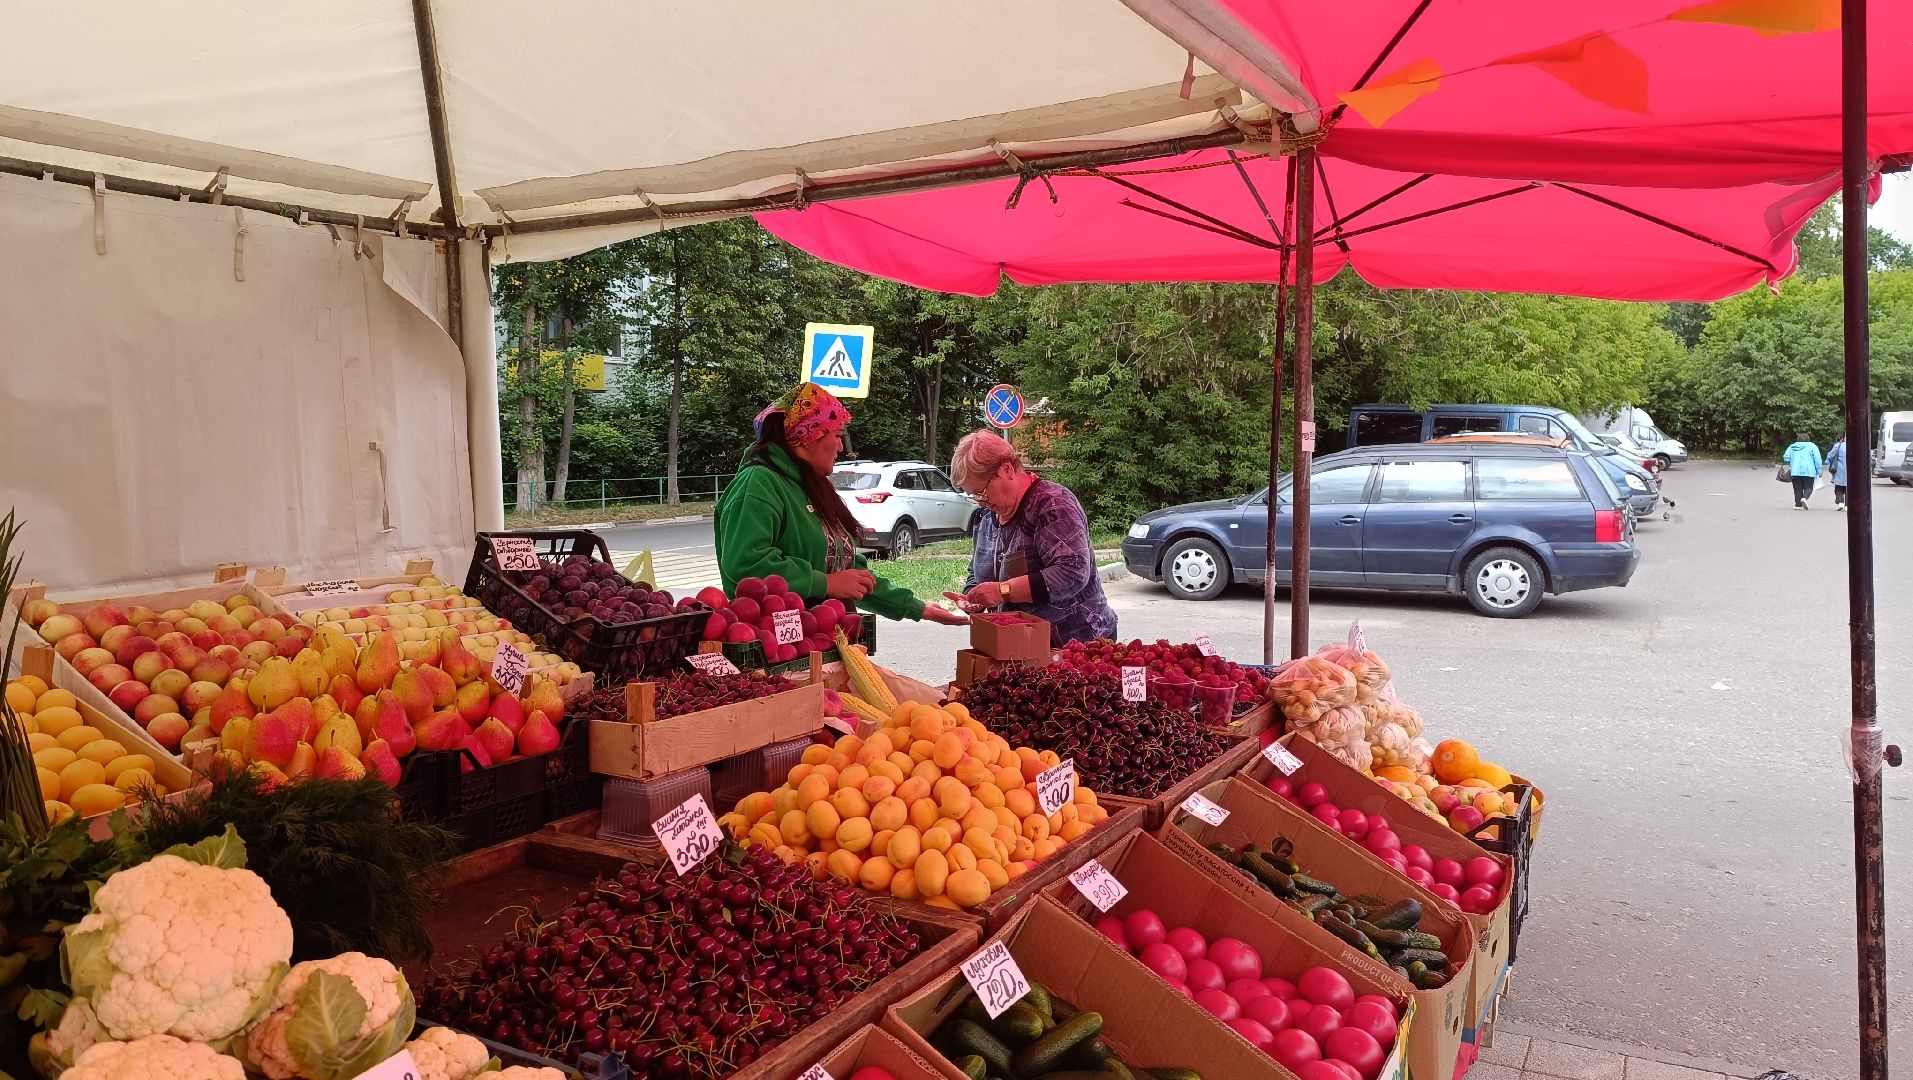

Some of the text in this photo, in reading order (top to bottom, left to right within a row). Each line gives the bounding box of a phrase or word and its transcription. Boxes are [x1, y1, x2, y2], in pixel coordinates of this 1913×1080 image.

[656, 803, 687, 832] Вишня
[1168, 829, 1195, 851] Exported
[1194, 850, 1203, 858] by
[1197, 860, 1221, 879] Ecuador
[1341, 950, 1381, 976] PRODUCT
[1380, 973, 1393, 983] OF
